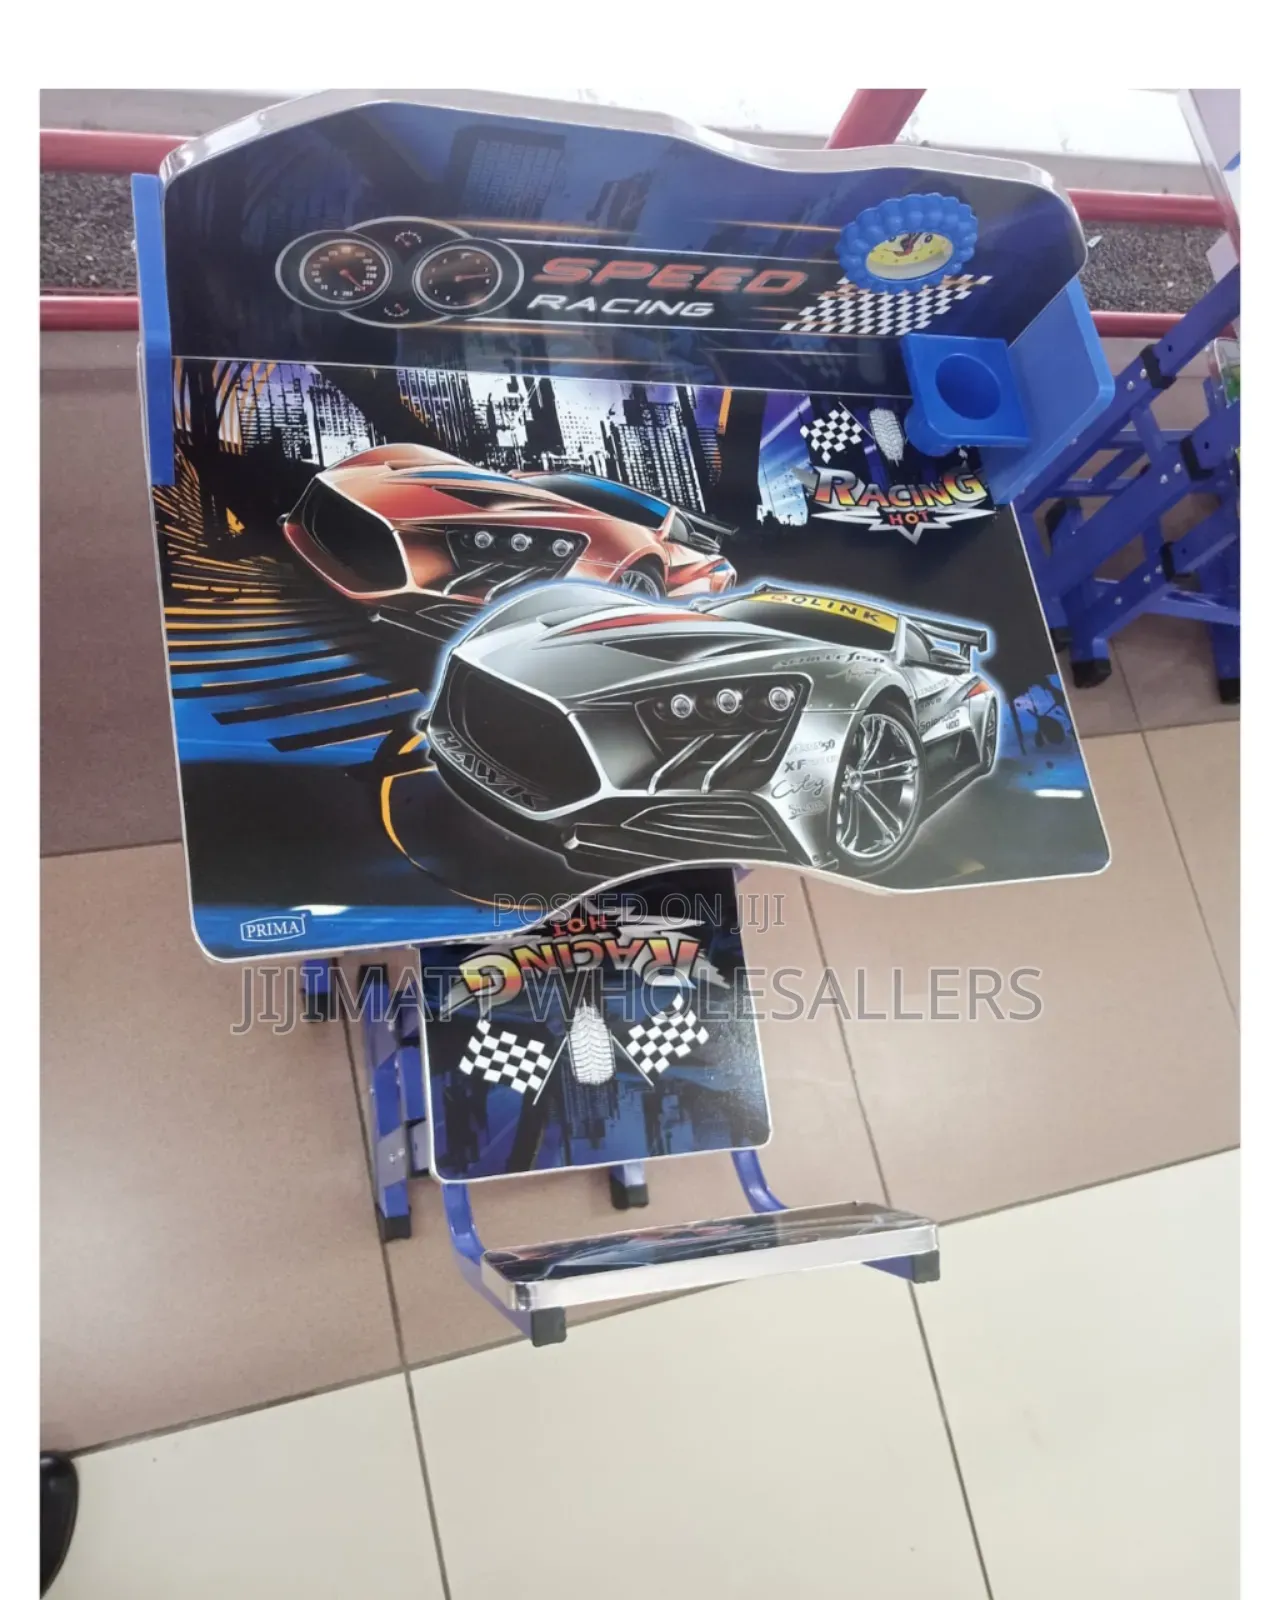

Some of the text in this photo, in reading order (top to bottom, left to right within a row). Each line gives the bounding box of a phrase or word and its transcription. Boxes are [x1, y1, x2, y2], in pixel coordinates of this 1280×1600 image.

[533, 257, 807, 293] SPEED
[527, 294, 715, 317] RACING
[814, 465, 988, 507] RACING
[888, 509, 929, 526] HOT
[435, 731, 549, 810] HAWK
[246, 920, 300, 938] PRIMA
[552, 915, 608, 937] HOT
[458, 937, 700, 1006] RACING
